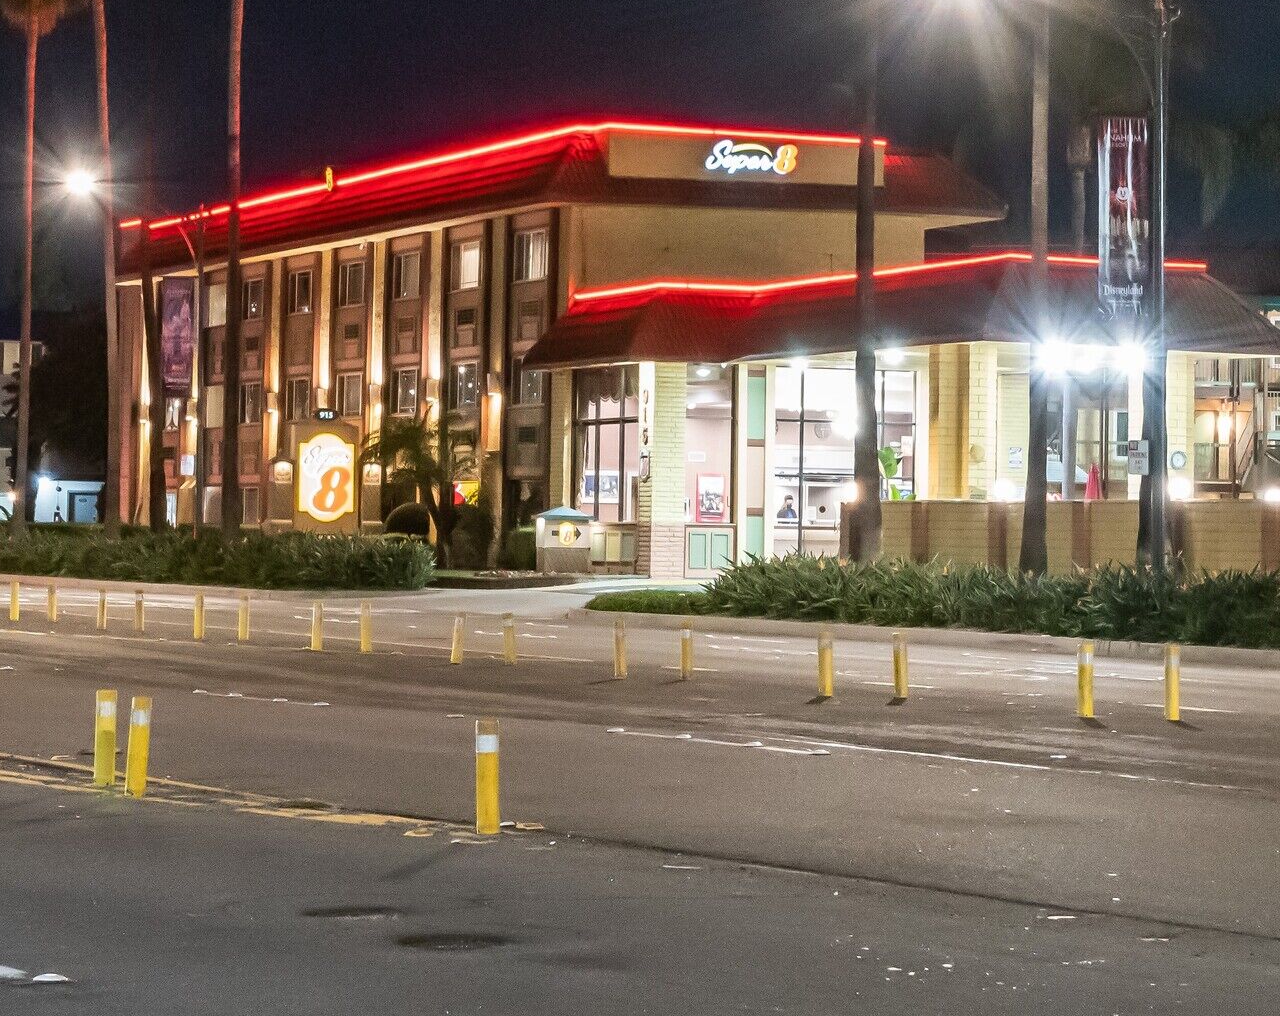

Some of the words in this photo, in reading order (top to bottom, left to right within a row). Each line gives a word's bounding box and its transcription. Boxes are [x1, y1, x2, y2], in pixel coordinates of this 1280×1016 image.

[705, 139, 773, 174] Super
[773, 144, 799, 175] 8
[319, 411, 334, 420] 915
[312, 466, 351, 513] 8
